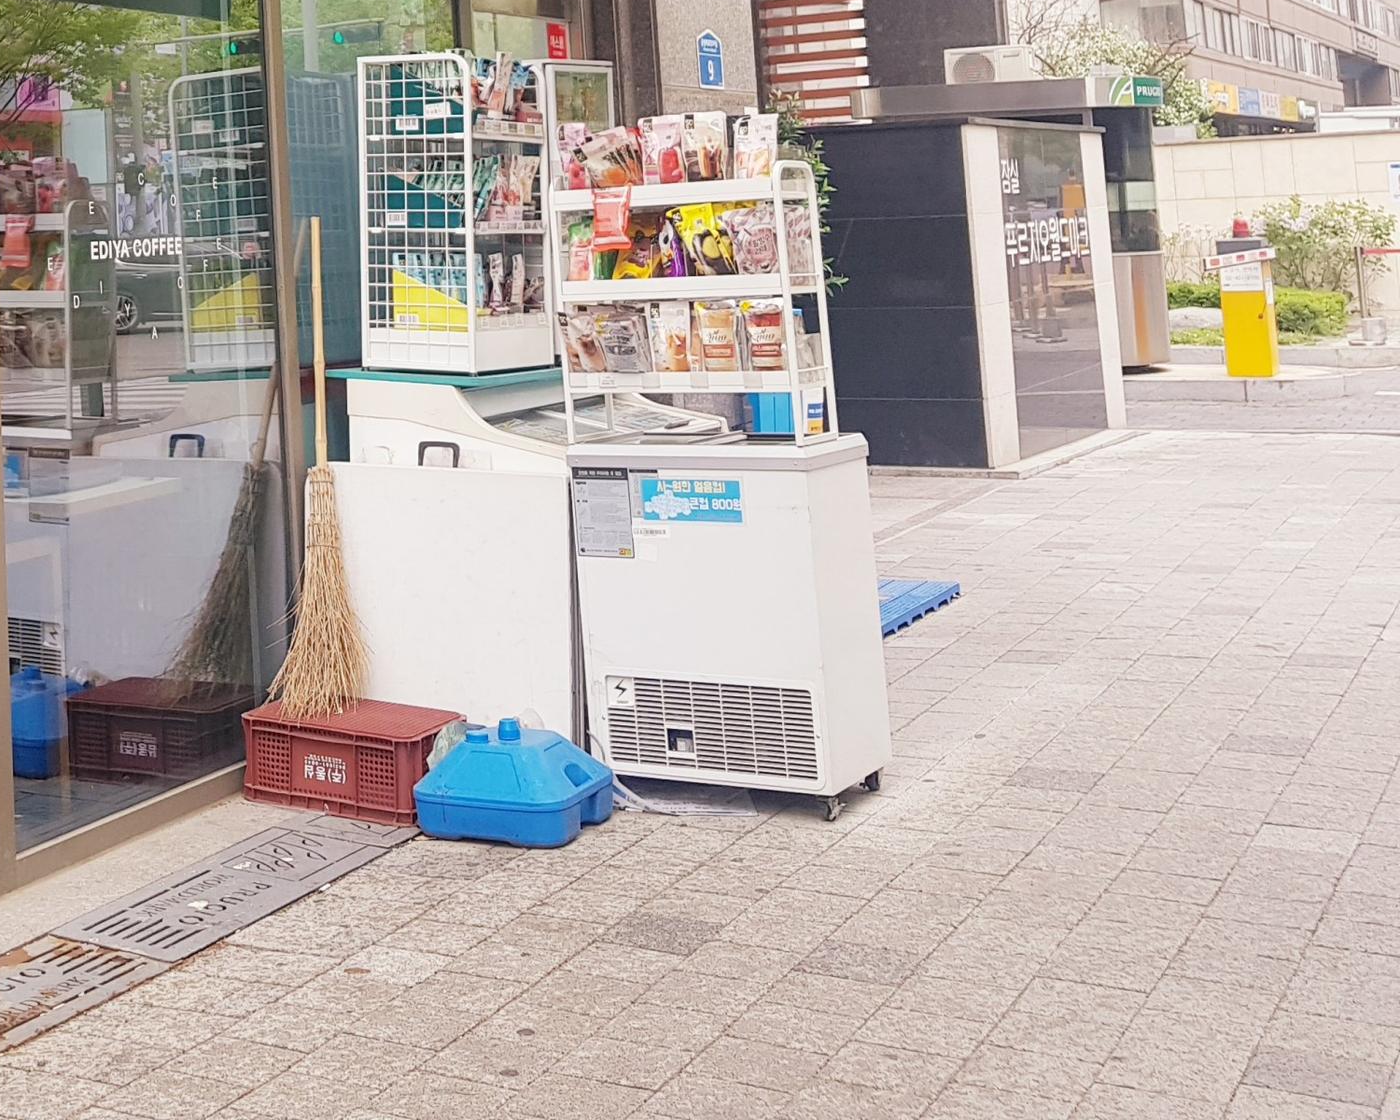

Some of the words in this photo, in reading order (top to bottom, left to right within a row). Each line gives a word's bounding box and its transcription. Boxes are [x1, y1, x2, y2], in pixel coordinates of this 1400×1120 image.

[706, 59, 714, 81] 9
[1000, 158, 1020, 194] 잠실
[90, 239, 130, 260] EDIYA
[133, 237, 182, 257] COFFEE
[1005, 216, 1090, 268] 푸르지오월드마크
[178, 881, 273, 926] PRUGIO
